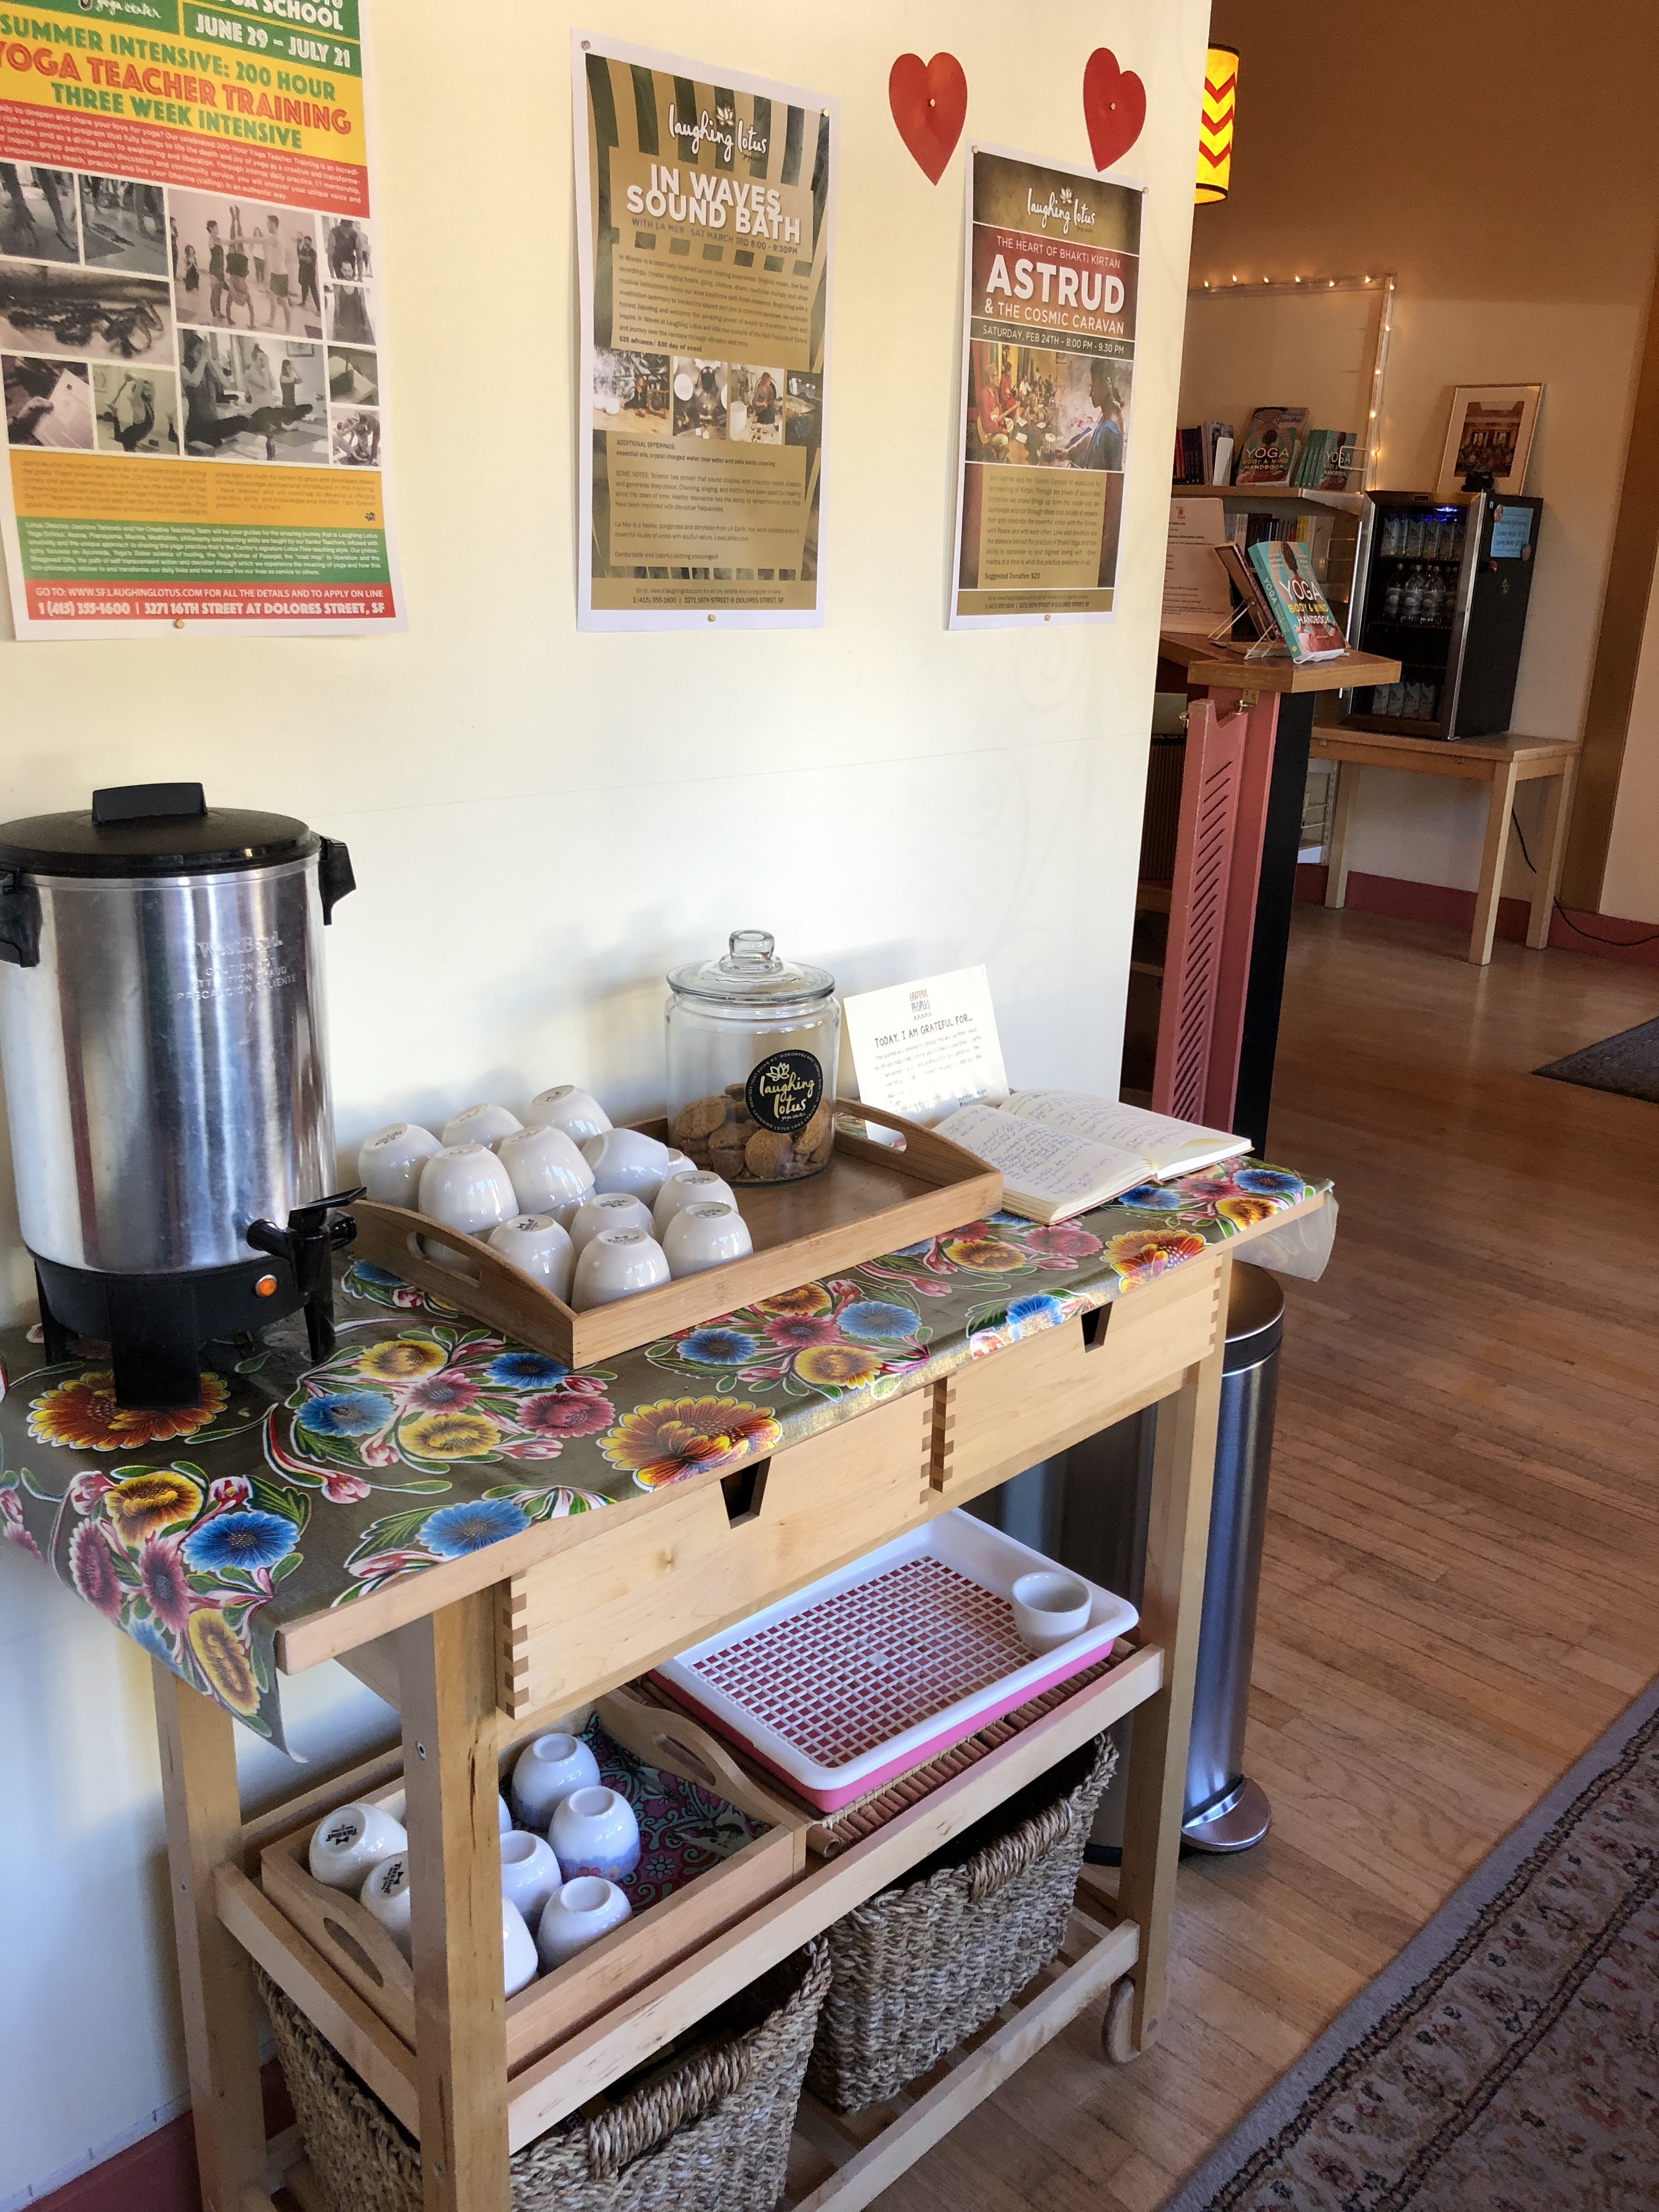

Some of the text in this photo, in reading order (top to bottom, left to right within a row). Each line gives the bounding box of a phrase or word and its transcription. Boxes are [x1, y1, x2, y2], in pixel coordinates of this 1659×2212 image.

[263, 0, 343, 31] SCHOOL
[196, 14, 242, 43] JUNE
[247, 26, 268, 48] 29
[288, 36, 329, 63] JULY
[334, 47, 351, 69] 21
[0, 14, 336, 101] SUMMER INTENSIVE: 200 HOUR
[86, 57, 217, 108] TEACHER
[222, 84, 352, 135] TRAINING
[51, 82, 302, 149] THREE WEEK INTENSIVE
[669, 103, 767, 162] laughing lotus
[651, 163, 781, 215] IN WAVES
[627, 185, 800, 243] SOUND BATH
[1026, 187, 1096, 234] laughing lotus
[632, 218, 653, 229] WITH
[656, 222, 665, 232] LA
[668, 224, 684, 235] MER
[691, 228, 704, 238] SAT
[707, 232, 733, 243] MARCH
[736, 235, 749, 246] 3RD
[997, 235, 1120, 269] THE HEART OF BHAKTI KIRTAN
[986, 254, 1125, 314] ASTRUD
[985, 298, 1124, 335] & THE COSMIC CARAVAN
[983, 325, 1024, 341] SATURDAY,
[1026, 332, 1040, 342] FEB
[1041, 334, 1059, 345] 24TH
[1066, 337, 1081, 348] 8:00
[1083, 340, 1092, 349] PM
[1098, 341, 1113, 353] 9:30
[1114, 345, 1124, 354] PM
[616, 439, 676, 450] ADDITIONAL OFFERINGS:
[1246, 448, 1289, 458] YOGA
[1327, 452, 1350, 464] YOGA
[985, 572, 1008, 581] Suggested
[1031, 572, 1040, 580] $20
[36, 588, 50, 596] GO
[51, 588, 66, 596] TO:
[67, 588, 202, 596] WWW.SF.LAUGHINGLOTUS.COM
[204, 588, 221, 596] FOR
[239, 589, 255, 597] THE
[256, 589, 290, 597] DETAILS
[291, 589, 309, 597] AND
[365, 589, 383, 597] LINE
[1264, 577, 1278, 604] YOGA
[1279, 580, 1323, 601] YOGA
[47, 601, 75, 616] (415)
[76, 601, 131, 614] 355-1600
[144, 602, 168, 614] 3271
[170, 602, 199, 614] 16TH
[201, 602, 244, 614] STREET
[245, 602, 262, 614] AT
[263, 602, 321, 614] DOLORES
[323, 602, 370, 614] STREET,
[371, 602, 386, 613] SF
[1288, 603, 1307, 613] BODY
[1314, 604, 1328, 612] MIND
[1296, 616, 1332, 624] HANDBOOK
[910, 989, 928, 1001] GRATEFUL
[911, 1000, 930, 1013] PEOPLES
[902, 1031, 906, 1040] I
[909, 1028, 918, 1039] AM
[921, 1018, 953, 1036] GRATEFUL
[759, 1071, 815, 1102] laughing
[753, 1109, 772, 1128] LAUGHING
[791, 1121, 803, 1130] YOGA
[804, 1105, 817, 1122] CENTER
[774, 1094, 806, 1119] lotus
